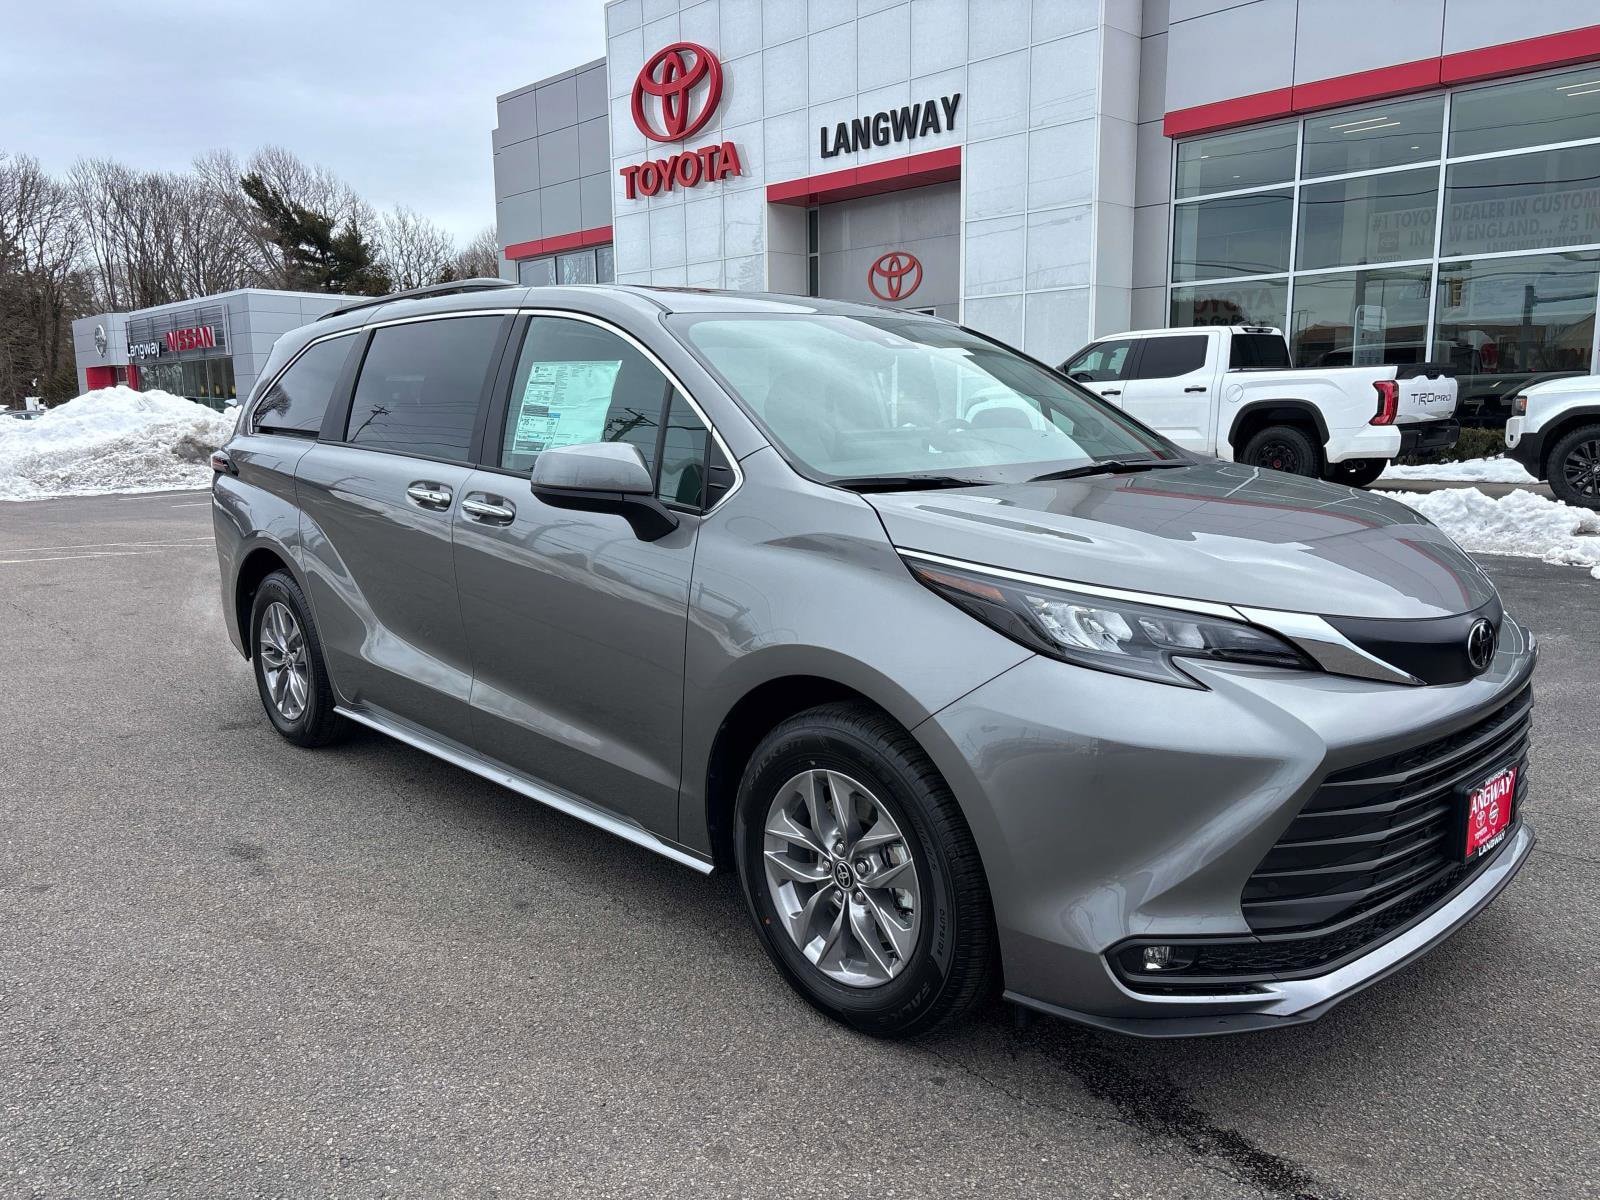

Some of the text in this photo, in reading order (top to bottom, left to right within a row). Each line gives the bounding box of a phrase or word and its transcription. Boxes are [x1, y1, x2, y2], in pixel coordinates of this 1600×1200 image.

[820, 93, 961, 158] LANGWAY
[620, 141, 742, 200] TOYOTA
[1394, 208, 1437, 229] TOYO
[1452, 200, 1504, 221] DEALER
[1510, 199, 1527, 216] IN
[128, 326, 217, 359] Langway NISSAN
